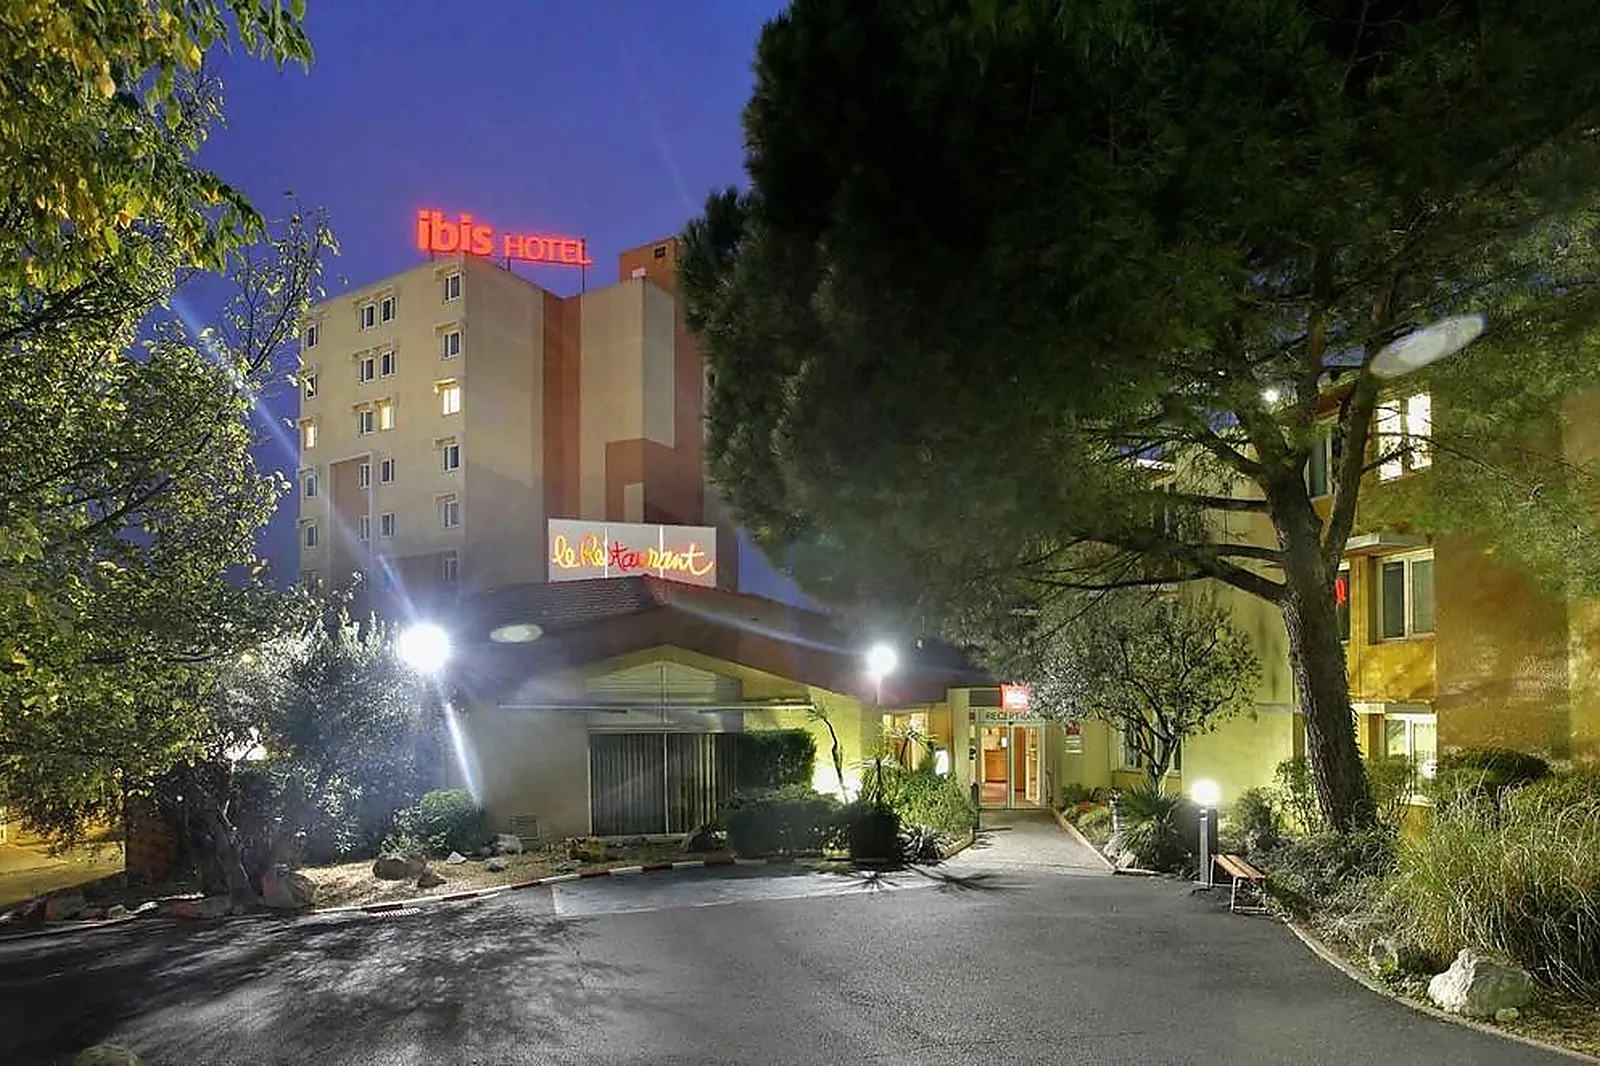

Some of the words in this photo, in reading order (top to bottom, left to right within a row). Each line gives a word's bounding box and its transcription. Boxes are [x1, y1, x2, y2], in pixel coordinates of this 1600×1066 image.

[417, 209, 493, 256] ibis
[504, 233, 592, 265] HOTEL
[553, 534, 580, 568] le
